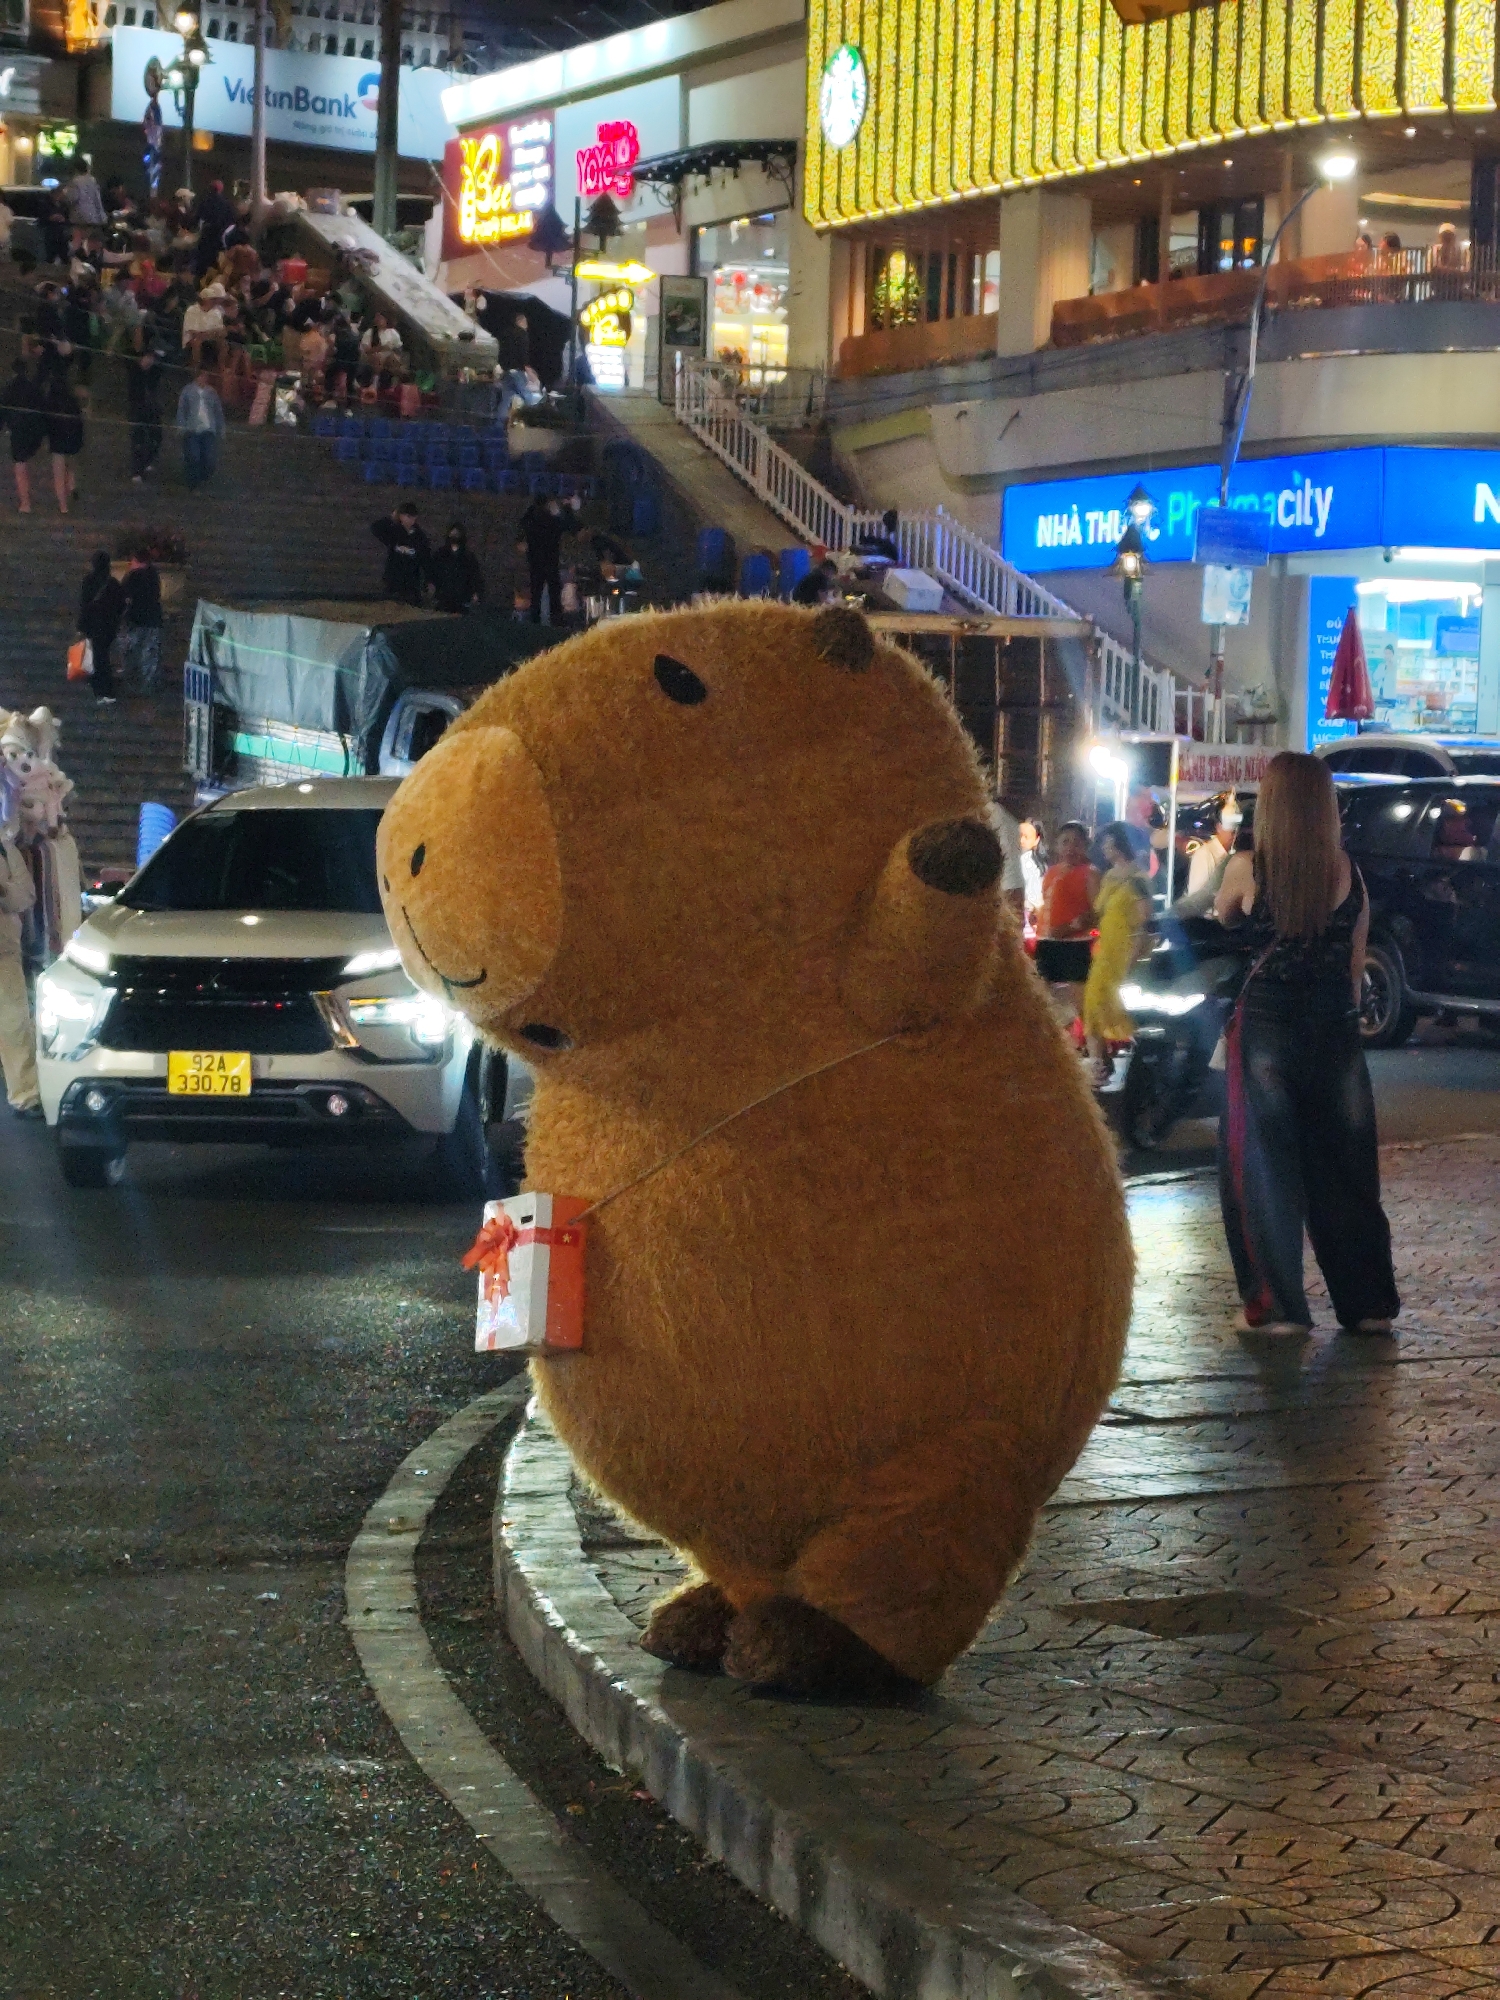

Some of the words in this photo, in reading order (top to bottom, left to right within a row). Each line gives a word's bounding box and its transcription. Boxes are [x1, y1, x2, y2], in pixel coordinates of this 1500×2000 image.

[1036, 504, 1082, 548] NHÀ
[192, 1054, 226, 1072] 92A
[177, 1074, 241, 1092] 330.78
